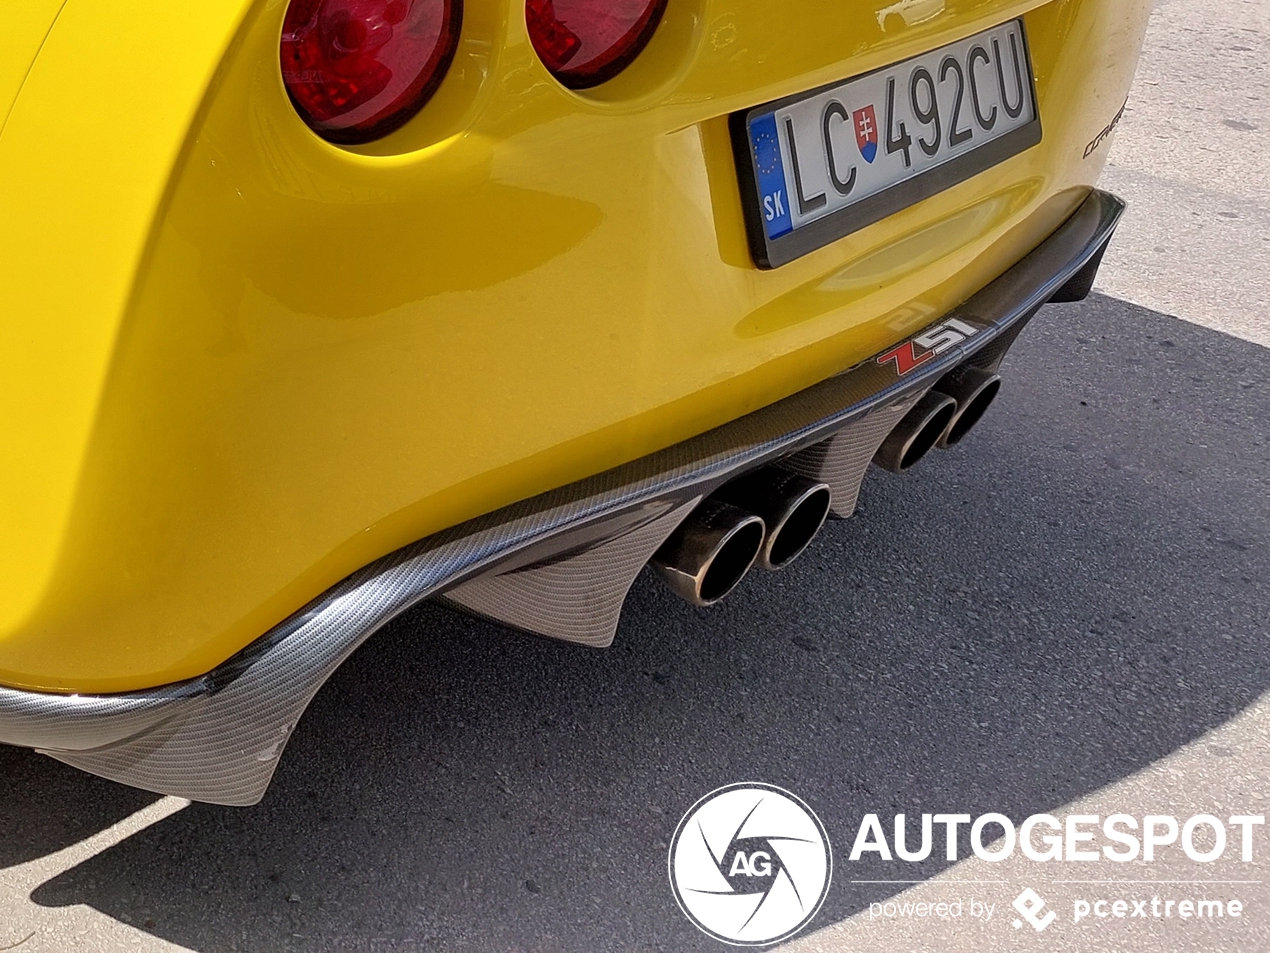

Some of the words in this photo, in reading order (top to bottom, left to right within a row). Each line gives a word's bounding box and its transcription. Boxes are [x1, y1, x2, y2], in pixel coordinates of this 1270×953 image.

[785, 100, 857, 216] LC
[885, 31, 1024, 168] 492CU
[763, 189, 785, 221] SK
